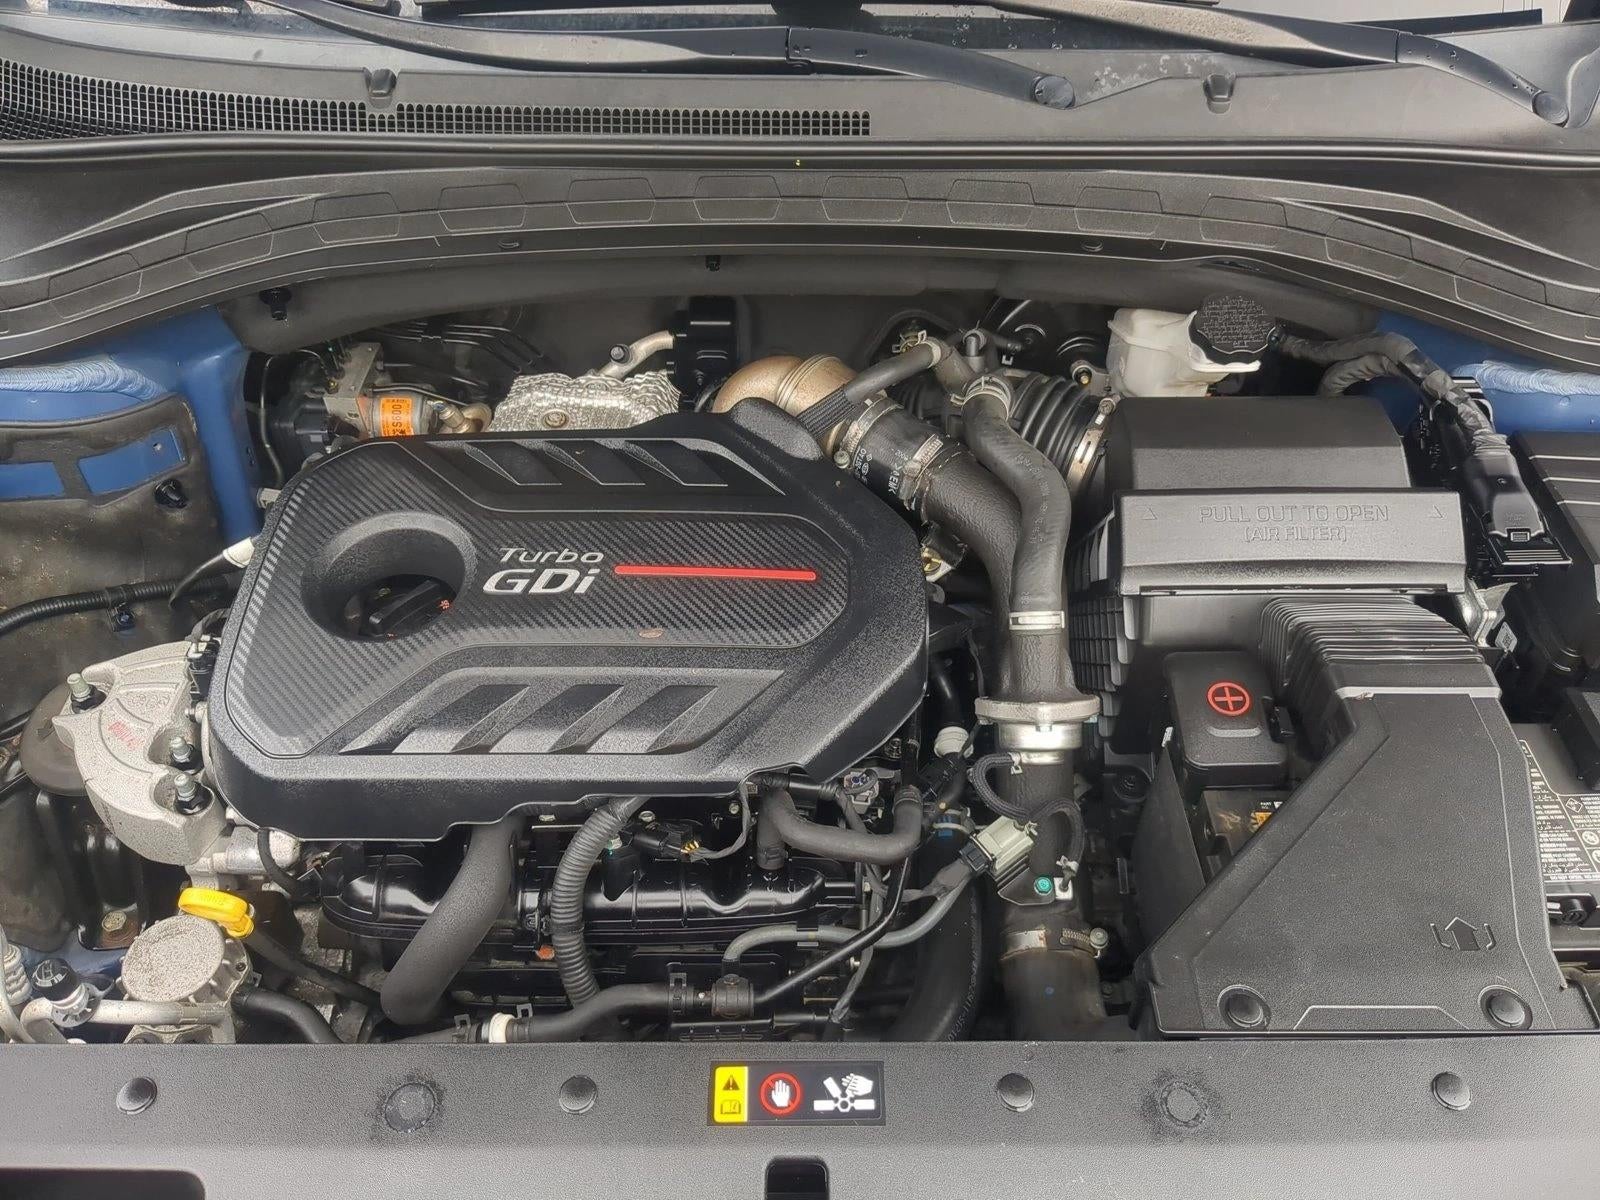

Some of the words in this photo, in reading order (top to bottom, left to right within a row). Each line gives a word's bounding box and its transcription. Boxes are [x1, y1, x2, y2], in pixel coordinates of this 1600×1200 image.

[1199, 504, 1251, 523] PULL
[1256, 504, 1297, 522] OUT
[1302, 504, 1329, 521] TO
[1335, 504, 1389, 522] OPEN
[500, 548, 604, 563] Turbo
[482, 568, 600, 595] GDi
